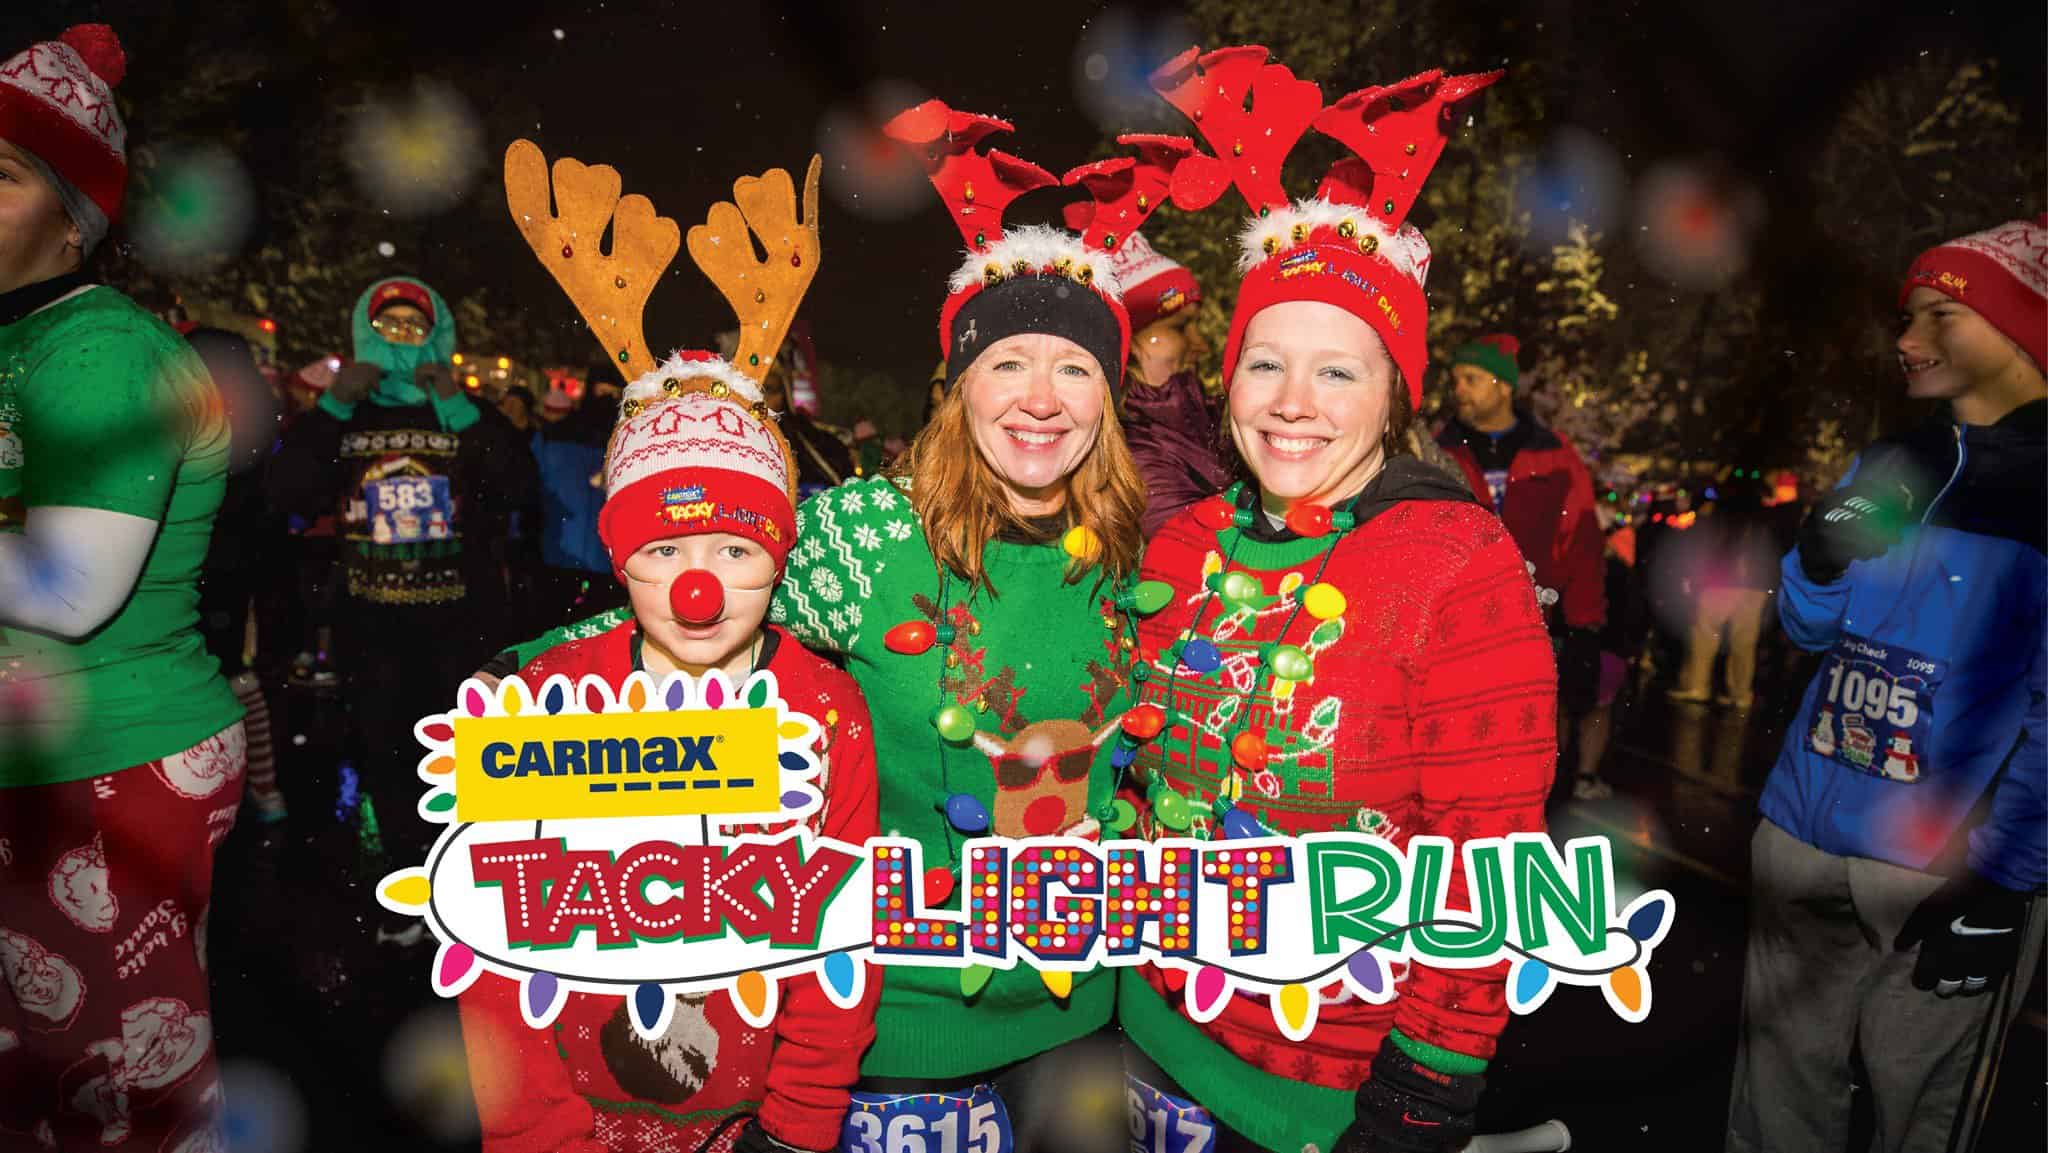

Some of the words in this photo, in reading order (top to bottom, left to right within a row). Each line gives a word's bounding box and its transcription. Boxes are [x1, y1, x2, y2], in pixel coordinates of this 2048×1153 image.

[377, 480, 433, 511] 583
[665, 501, 715, 521] TACKY
[1857, 642, 1888, 660] Check
[1906, 657, 1936, 674] 1095
[1827, 664, 1919, 728] 1095
[850, 1101, 1000, 1153] 3615
